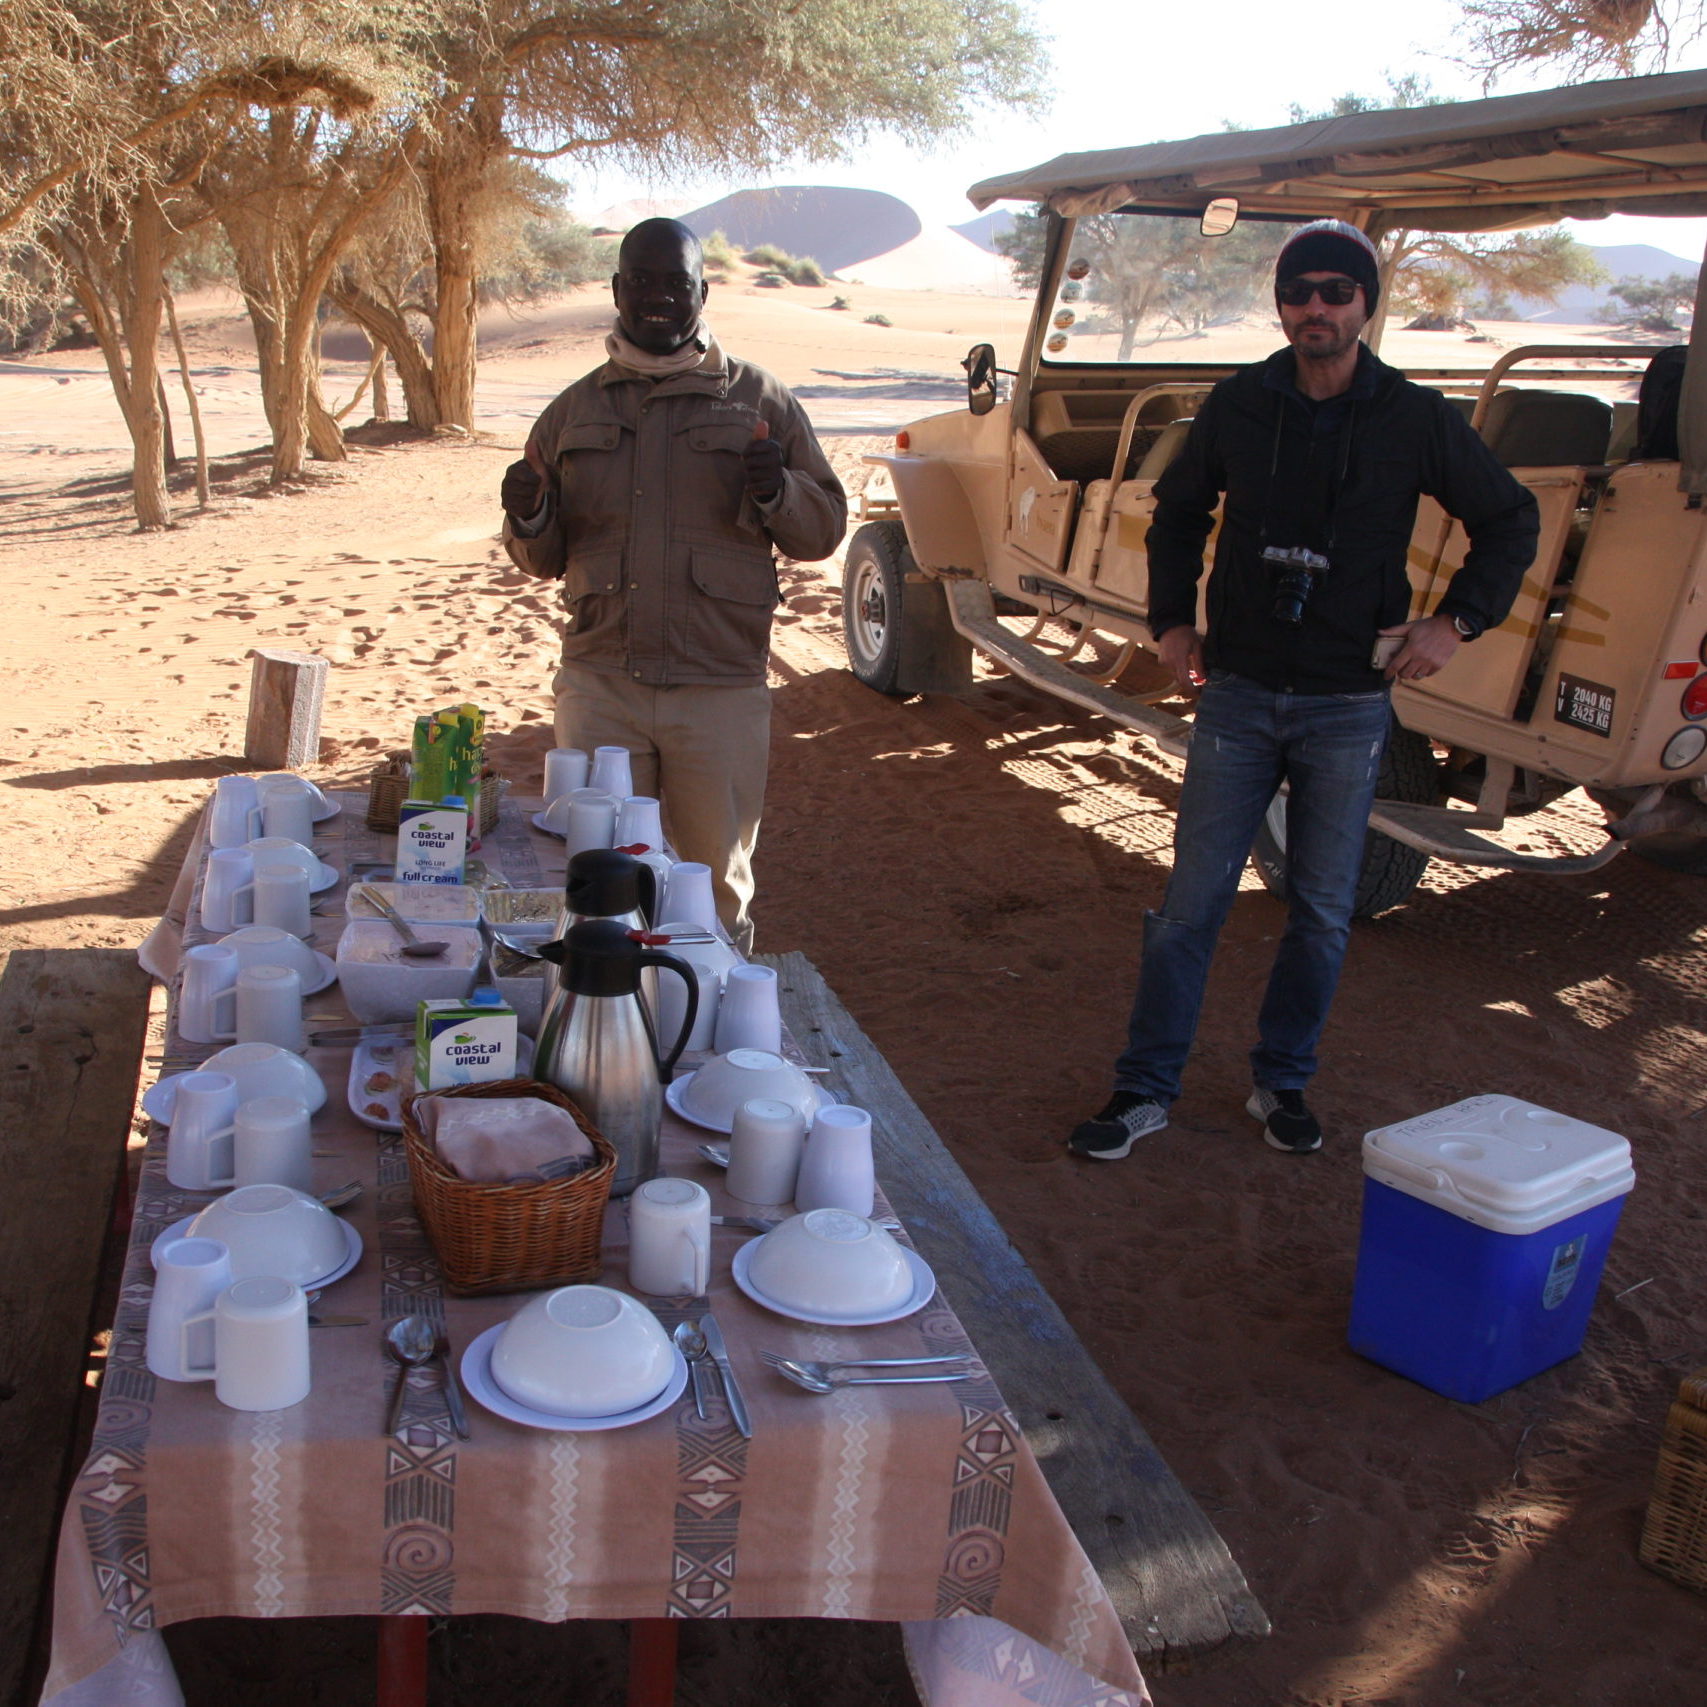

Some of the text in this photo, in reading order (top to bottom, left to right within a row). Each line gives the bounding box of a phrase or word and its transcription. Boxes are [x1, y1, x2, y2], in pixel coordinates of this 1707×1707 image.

[1561, 681, 1566, 695] T
[1558, 698, 1564, 712] V
[1573, 686, 1612, 711] 2040 KG
[1571, 703, 1609, 728] 2425 KG
[411, 831, 454, 840] coastal
[418, 840, 446, 848] view
[402, 871, 458, 883] full cream
[445, 1042, 502, 1055] coastal
[455, 1055, 490, 1066] view
